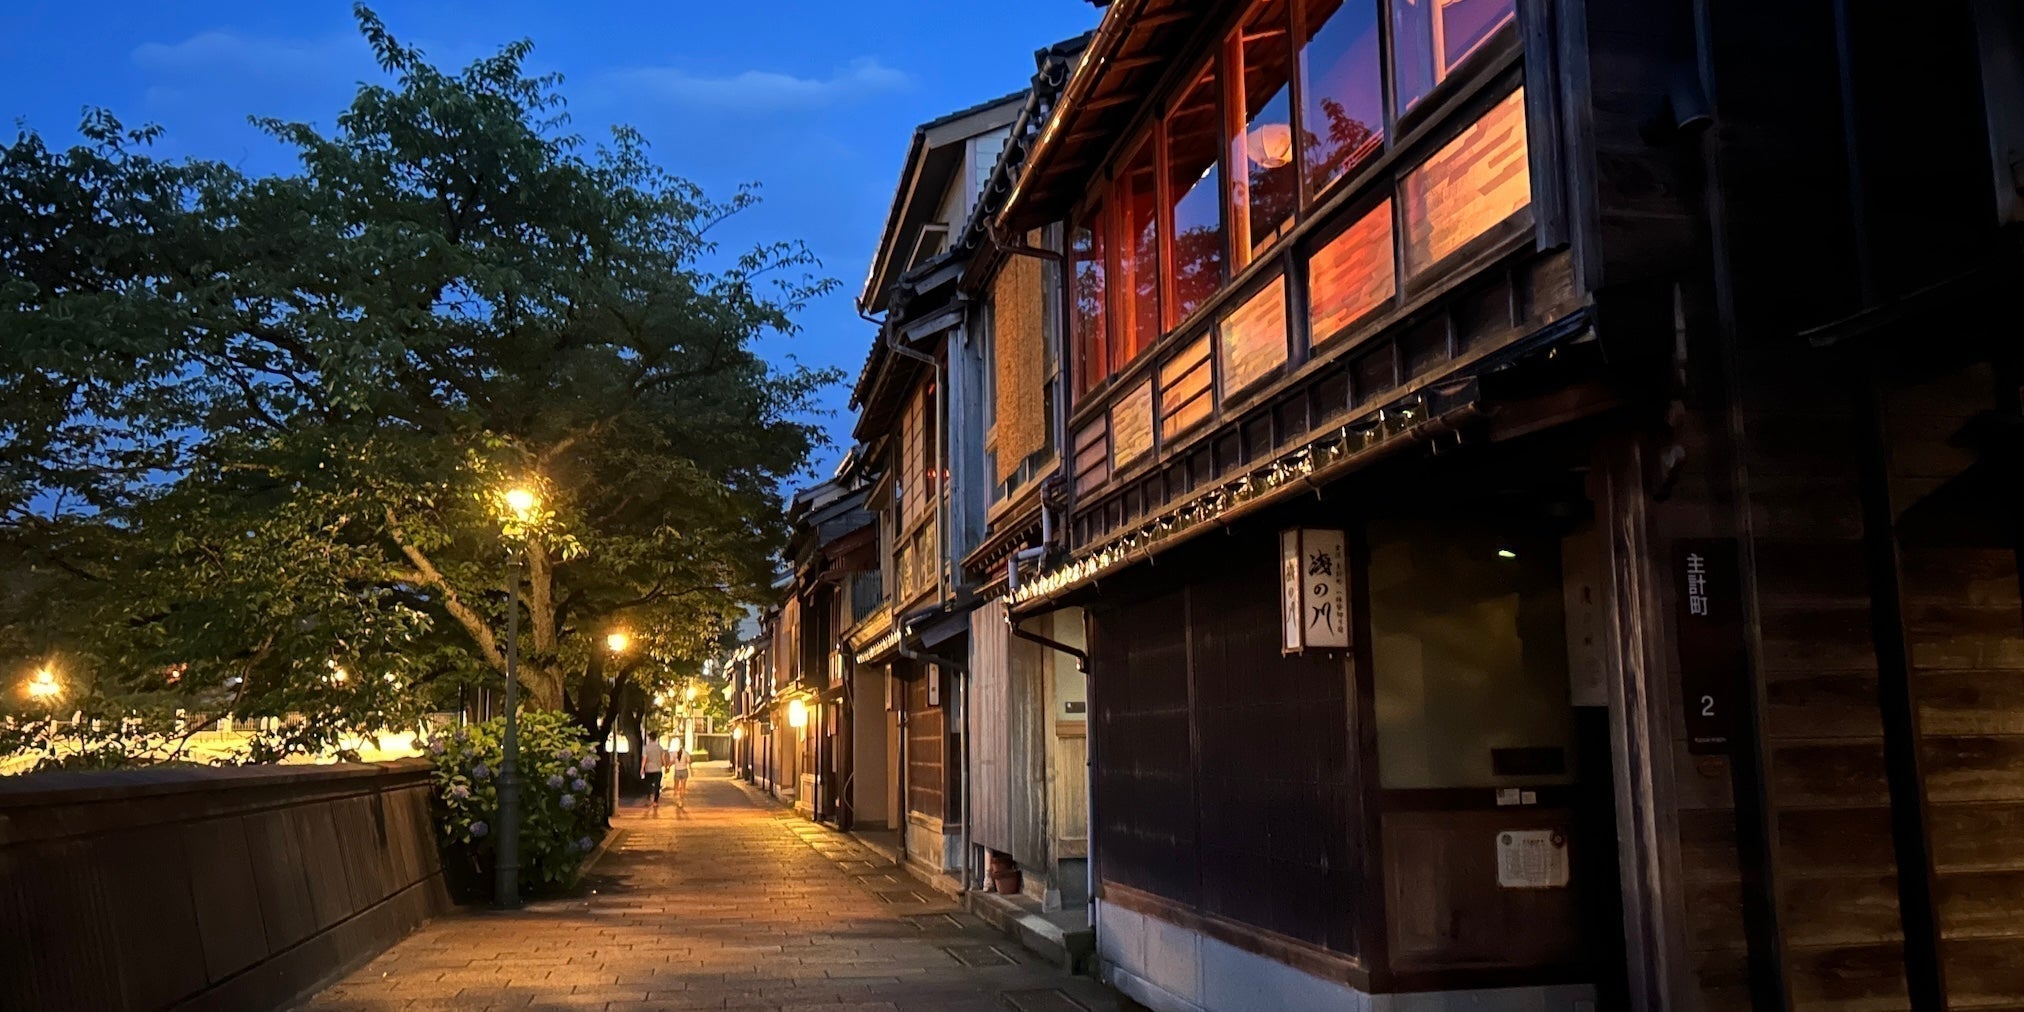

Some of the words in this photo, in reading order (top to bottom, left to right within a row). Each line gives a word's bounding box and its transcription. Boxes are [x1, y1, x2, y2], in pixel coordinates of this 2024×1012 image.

[1687, 553, 1708, 616] 主計町
[1701, 695, 1715, 717] 2
